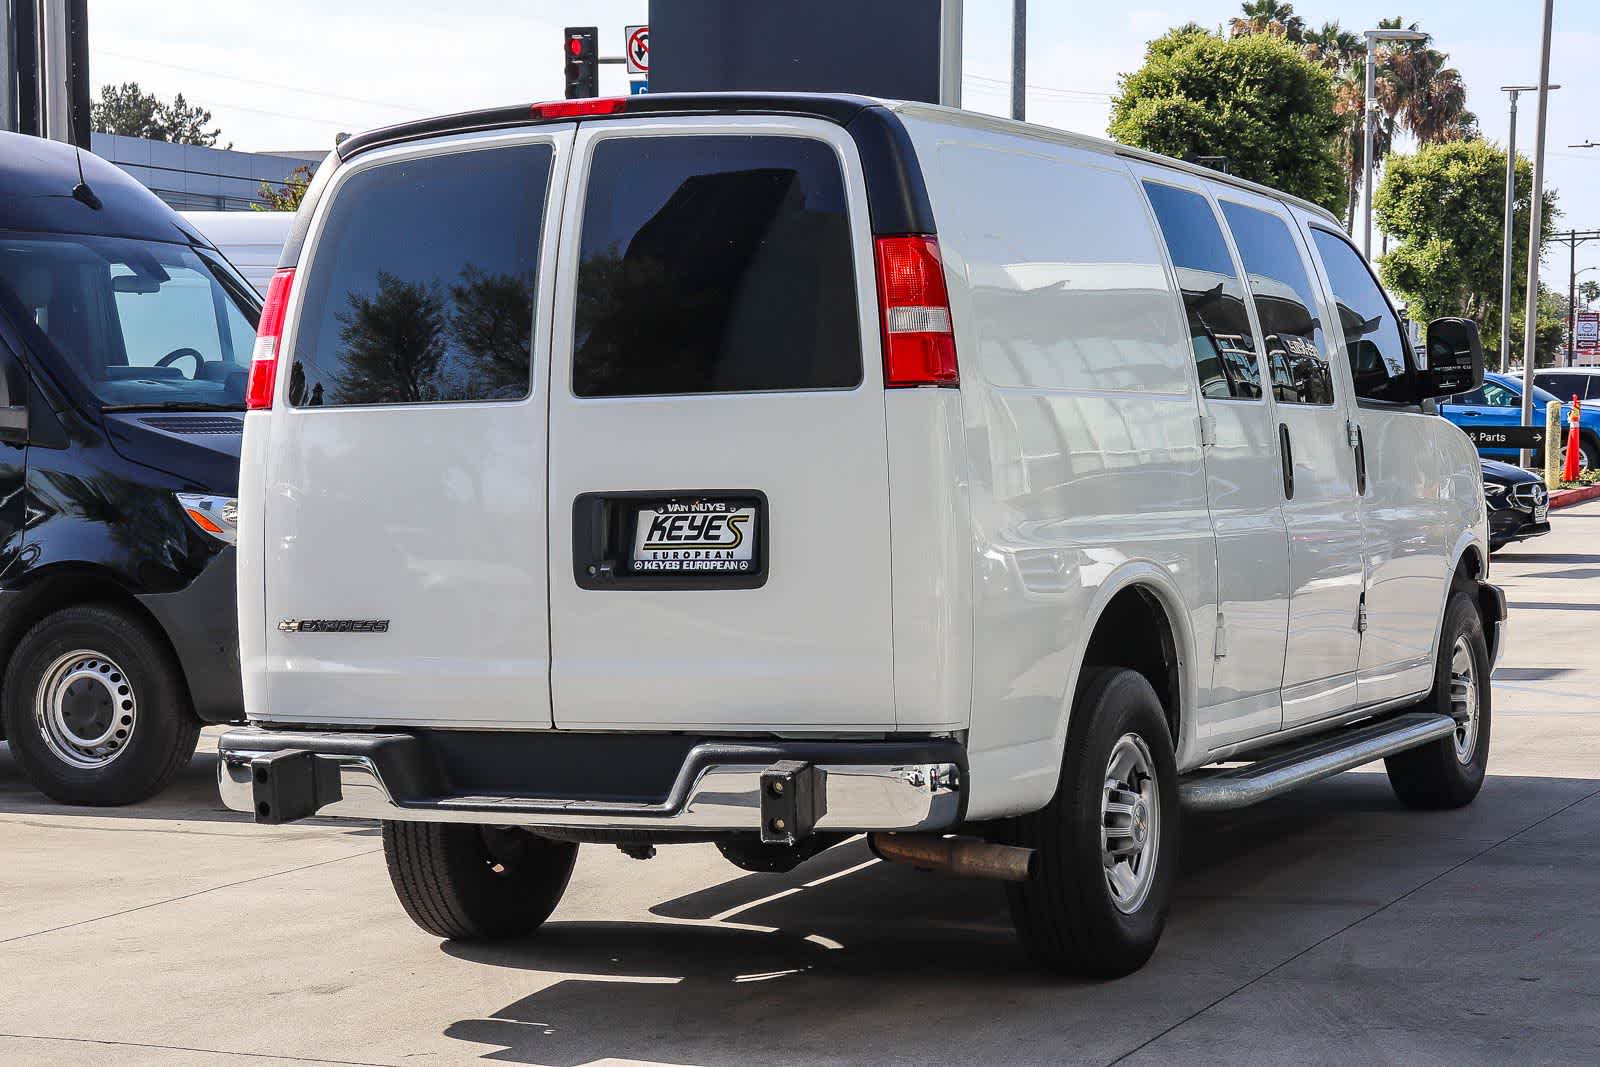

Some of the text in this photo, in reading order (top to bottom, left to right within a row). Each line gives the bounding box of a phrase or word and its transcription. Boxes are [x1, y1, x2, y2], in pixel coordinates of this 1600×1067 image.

[1479, 432, 1506, 442] Parts
[667, 503, 726, 512] VAN NUYS
[644, 514, 750, 549] KEYES
[653, 551, 734, 559] EUROPEAN
[643, 560, 738, 570] KEYES EUROPEAN
[302, 620, 390, 632] EXPRESS
